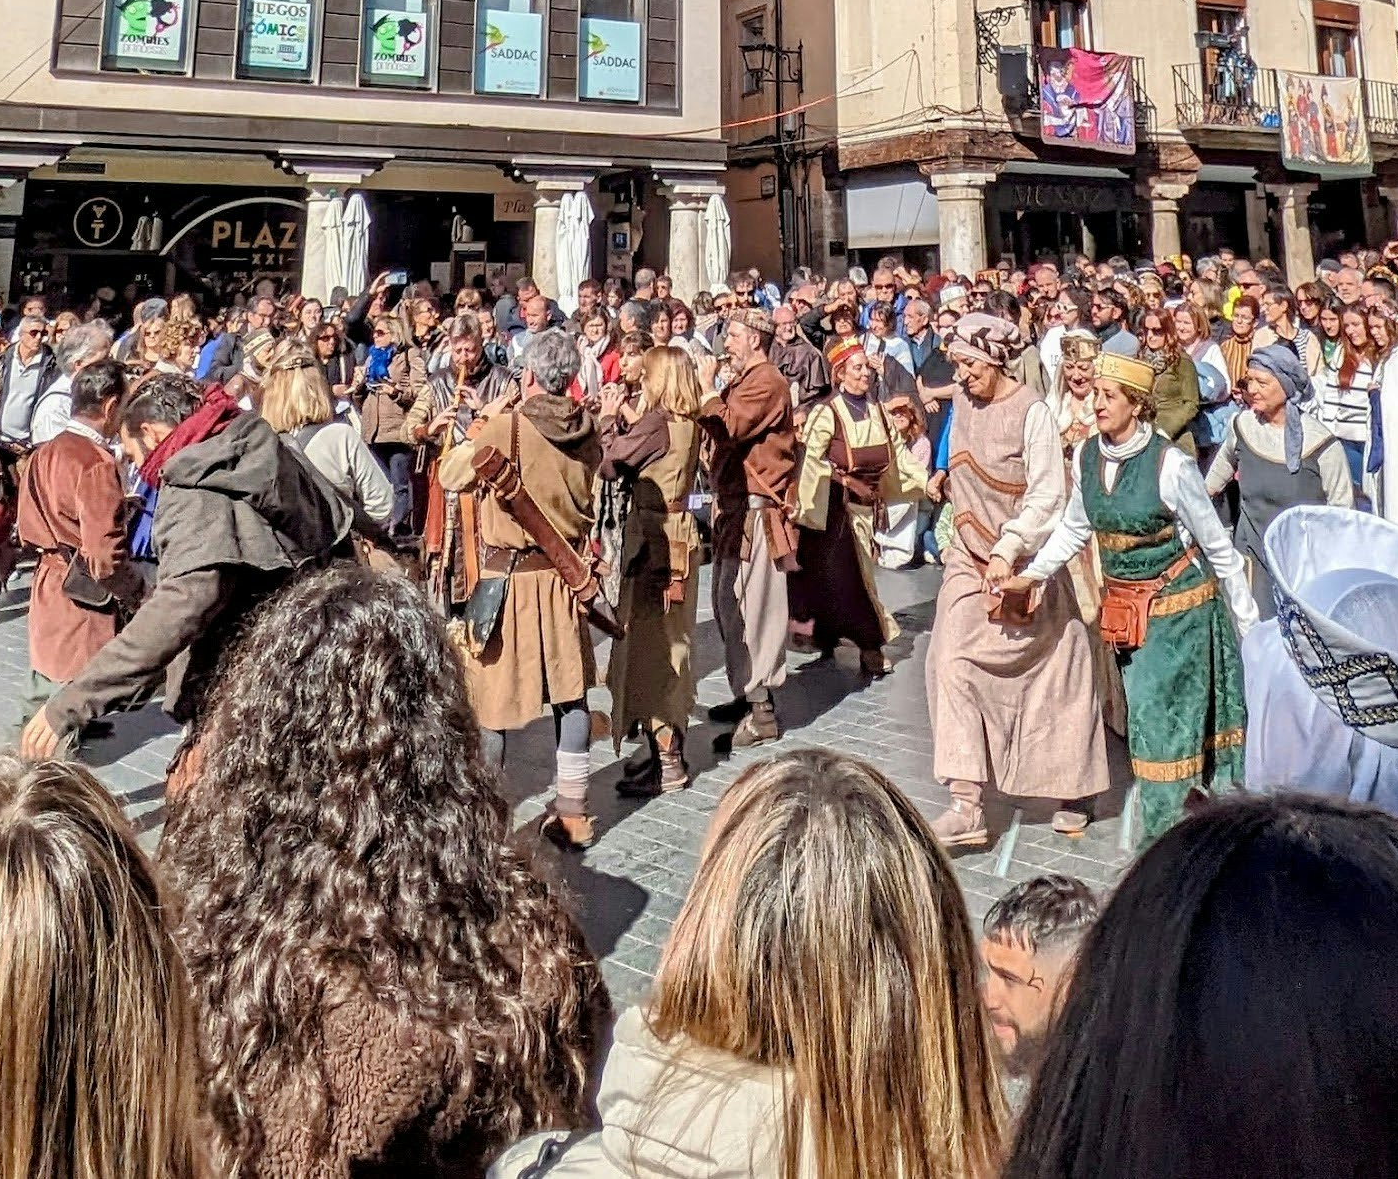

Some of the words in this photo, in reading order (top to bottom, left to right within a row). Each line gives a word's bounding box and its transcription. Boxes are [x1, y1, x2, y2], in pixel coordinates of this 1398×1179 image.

[247, 1, 308, 18] JUEGOS
[120, 33, 170, 46] ZOMBIES
[374, 52, 416, 63] ZOMBIES
[491, 48, 538, 61] SADDAC
[593, 56, 637, 69] SADDAC
[503, 197, 531, 214] Pla
[211, 219, 299, 249] PLAZ
[251, 253, 283, 265] XXI
